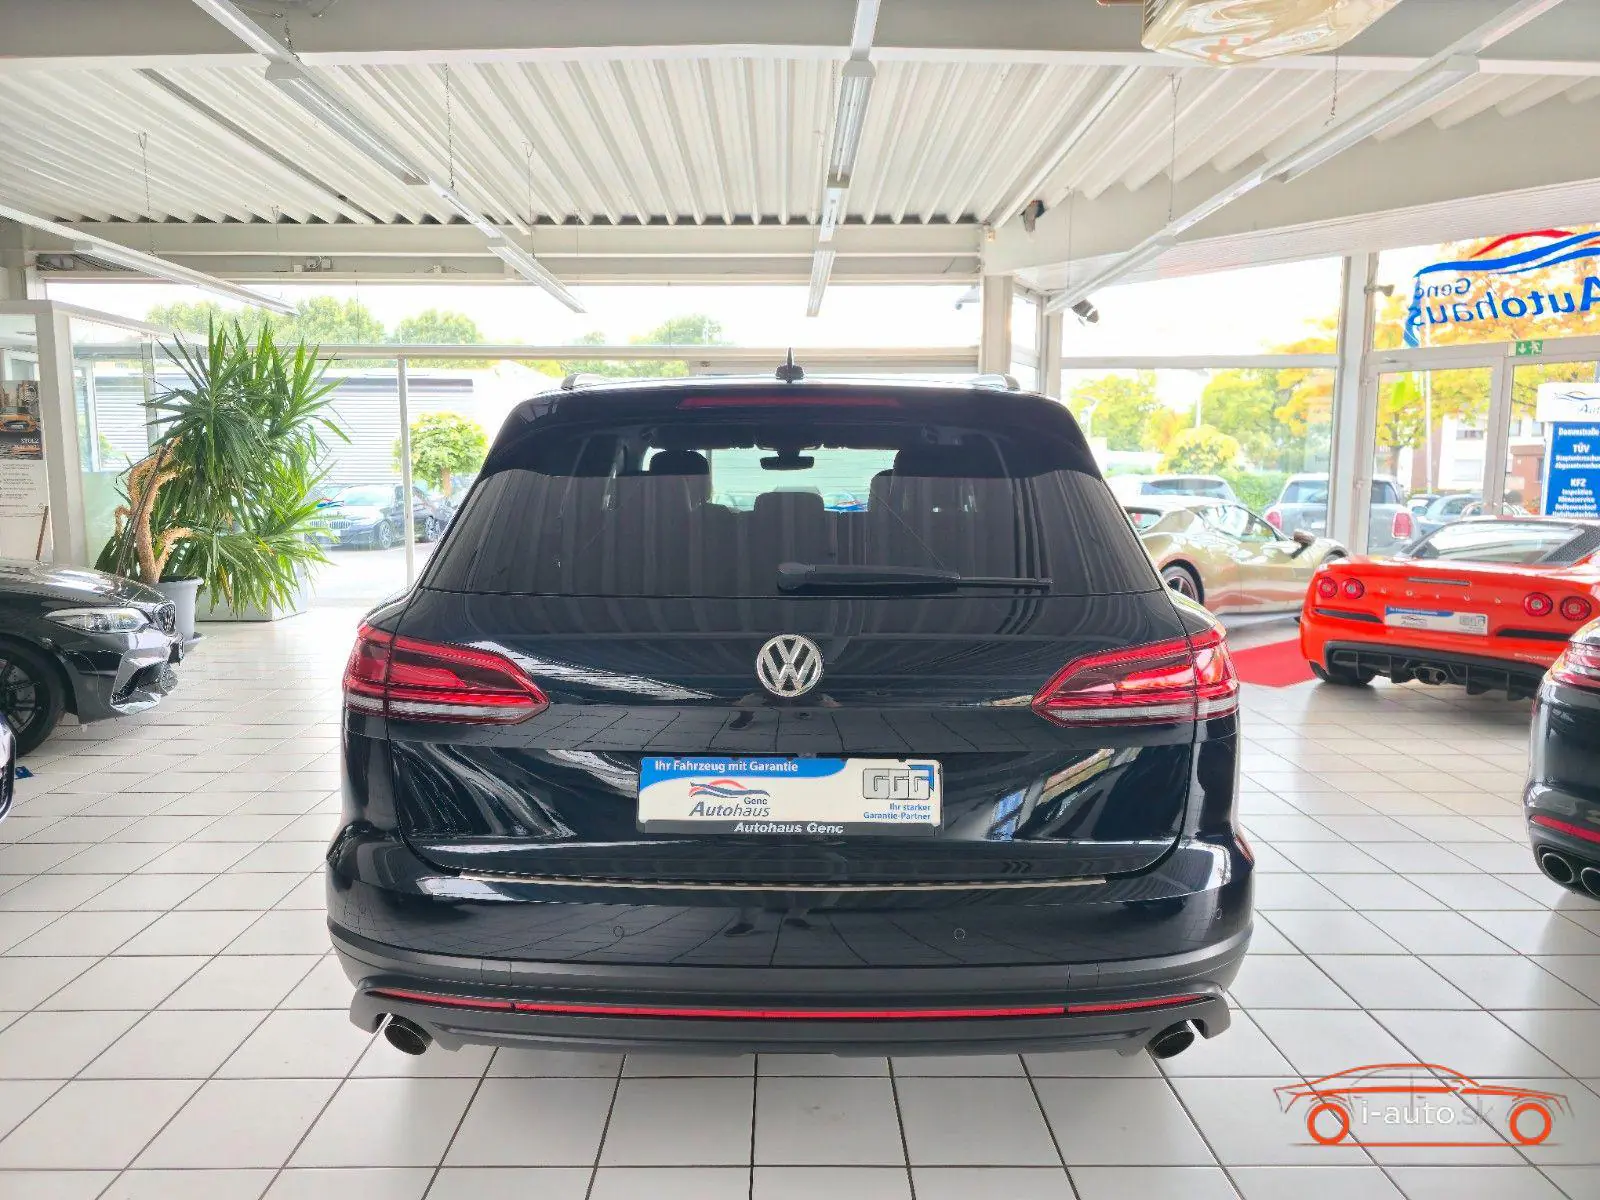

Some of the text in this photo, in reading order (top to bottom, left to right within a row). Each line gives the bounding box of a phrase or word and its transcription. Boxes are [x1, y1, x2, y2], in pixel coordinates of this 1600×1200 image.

[1573, 441, 1590, 453] TÜV
[655, 761, 799, 773] Ihr Fahrzeug mit Garantie
[743, 797, 768, 805] Genc
[889, 803, 931, 811] Ihr starker
[688, 801, 771, 817] Autohaus
[734, 822, 844, 834] Autohaus Genc
